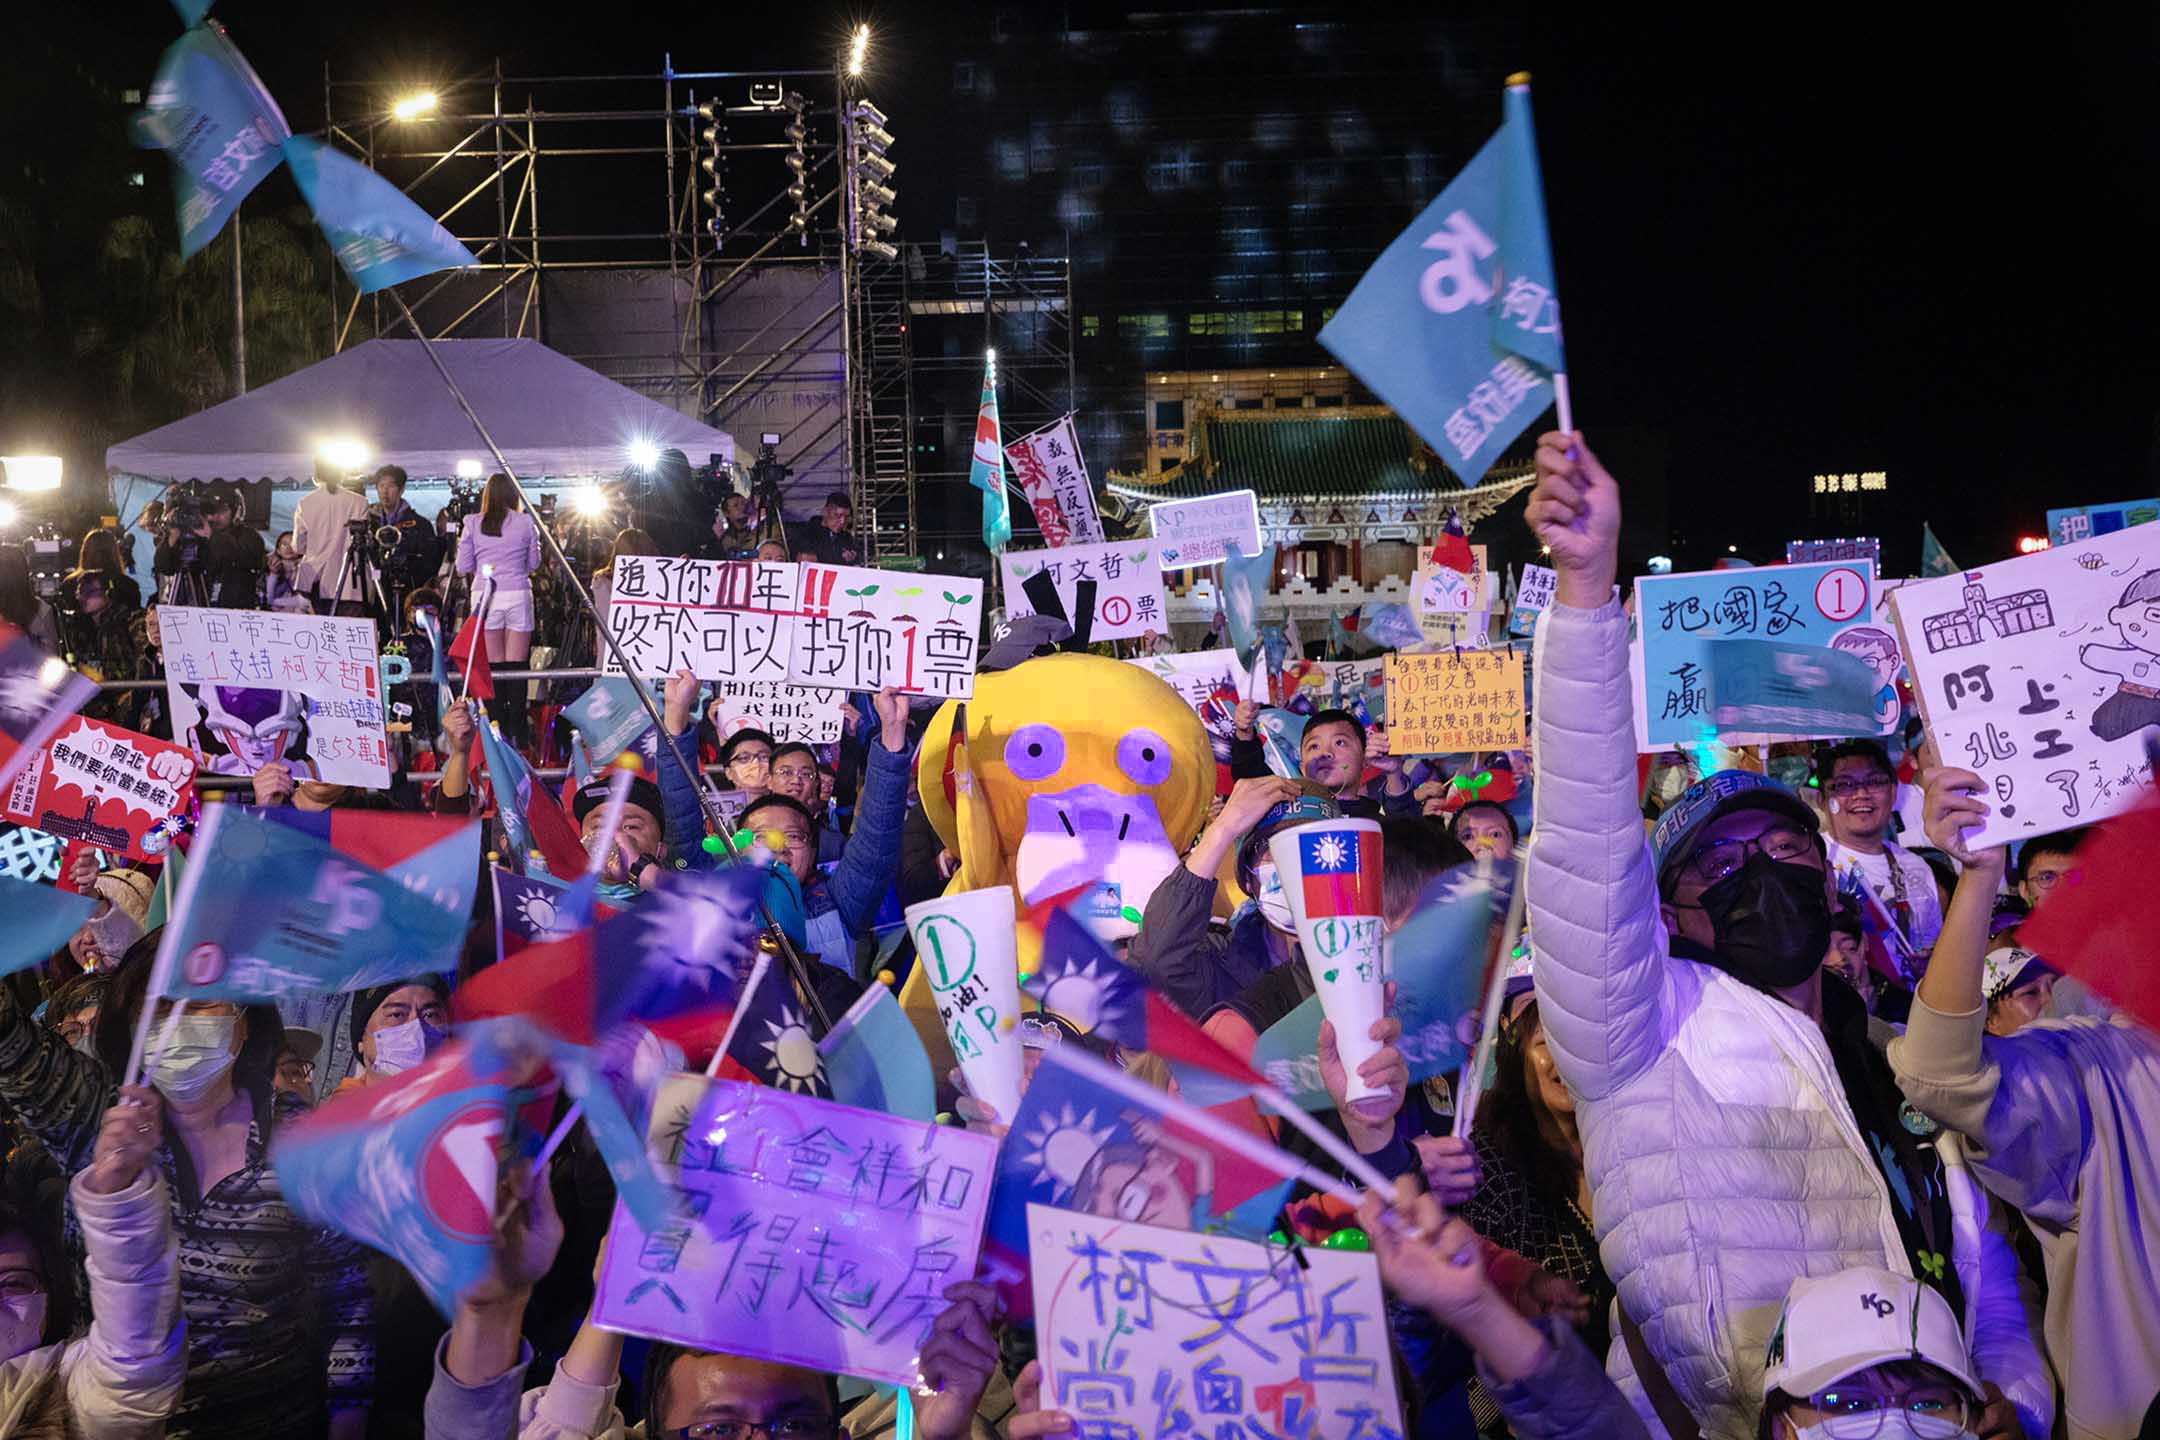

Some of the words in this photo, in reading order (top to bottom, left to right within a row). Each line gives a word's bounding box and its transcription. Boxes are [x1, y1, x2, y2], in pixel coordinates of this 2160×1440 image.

[1039, 552, 1124, 585] 柯文哲
[1659, 582, 1806, 636] 把國家
[742, 702, 814, 719] 我相信
[109, 743, 146, 771] 阿北
[53, 742, 178, 810] 我們要你當總統!
